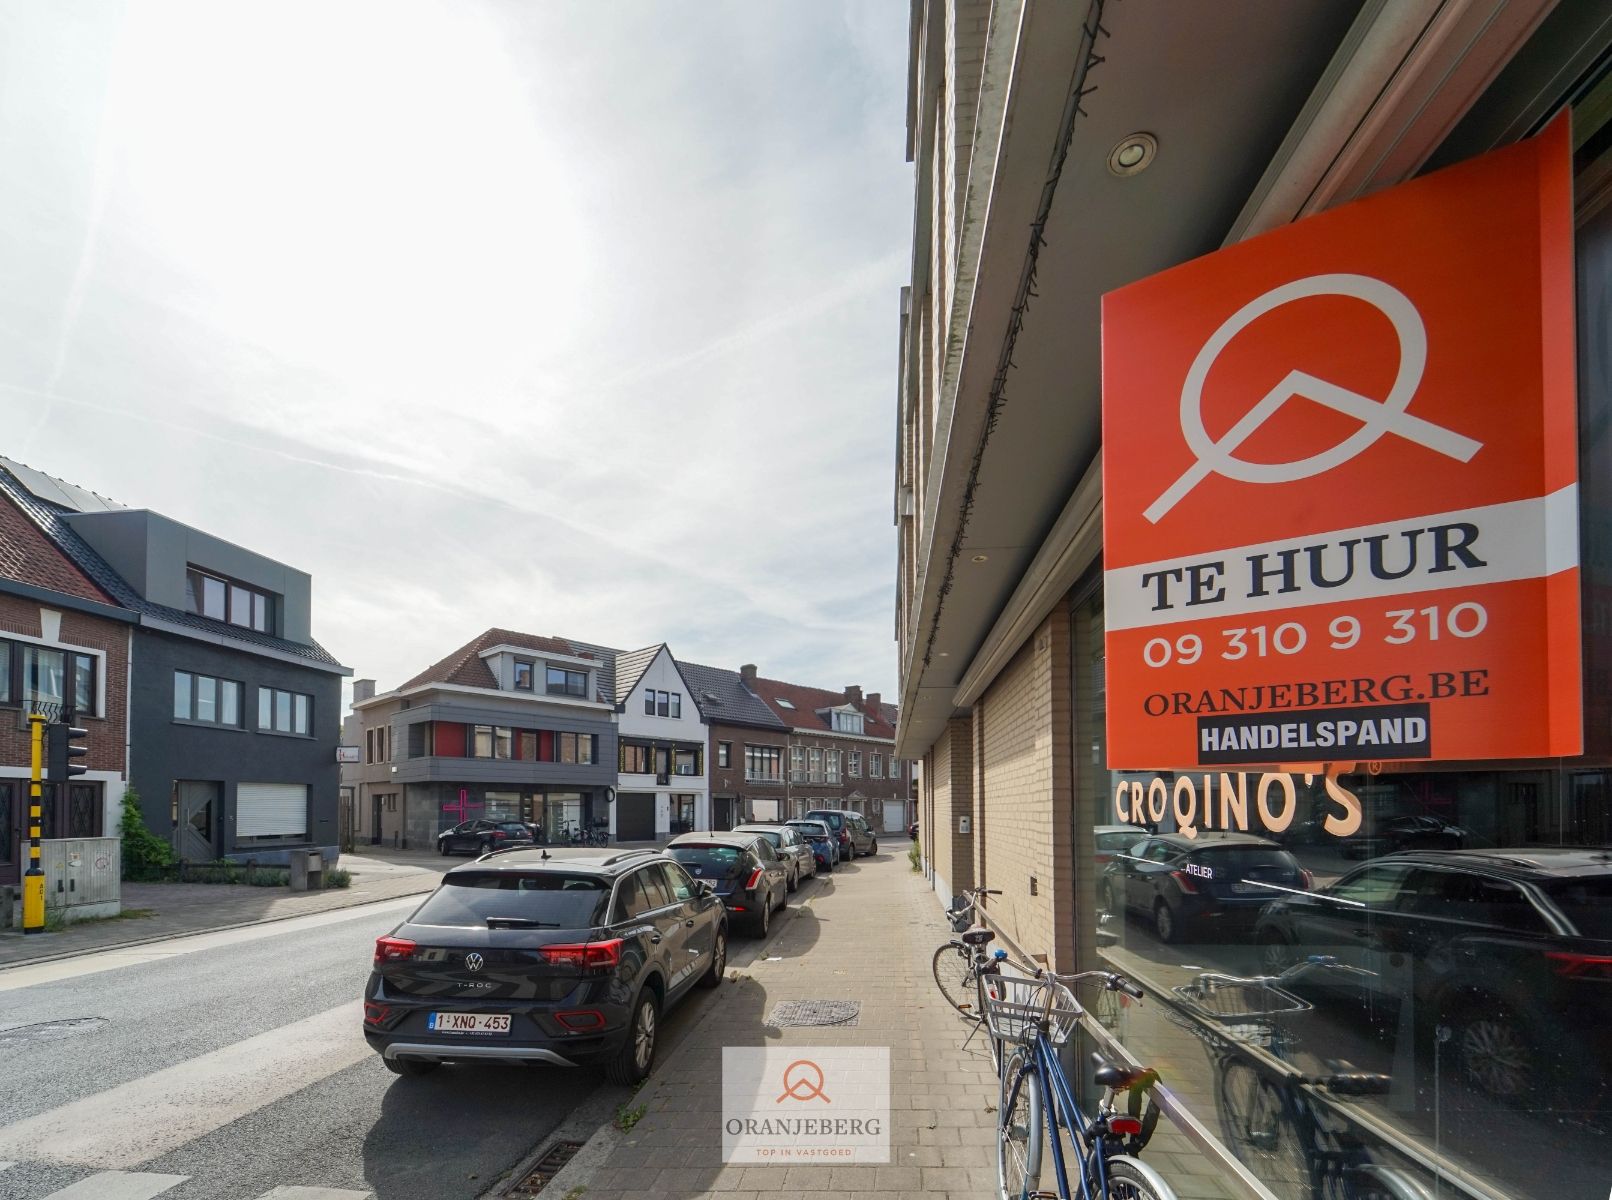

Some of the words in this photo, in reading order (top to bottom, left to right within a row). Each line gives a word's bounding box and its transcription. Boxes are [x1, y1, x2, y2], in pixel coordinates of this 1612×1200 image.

[1142, 561, 1226, 611] TE
[1246, 522, 1487, 598] HUUR
[1143, 634, 1203, 668] 09
[1221, 622, 1307, 660] 310
[1328, 615, 1361, 650] 9
[1384, 602, 1488, 645] 310
[1143, 669, 1490, 717] ORANJEBERG.BE
[1201, 717, 1427, 752] HANDELSPAND
[1115, 762, 1362, 839] CROQINO'S
[1185, 863, 1213, 879] ATELIER
